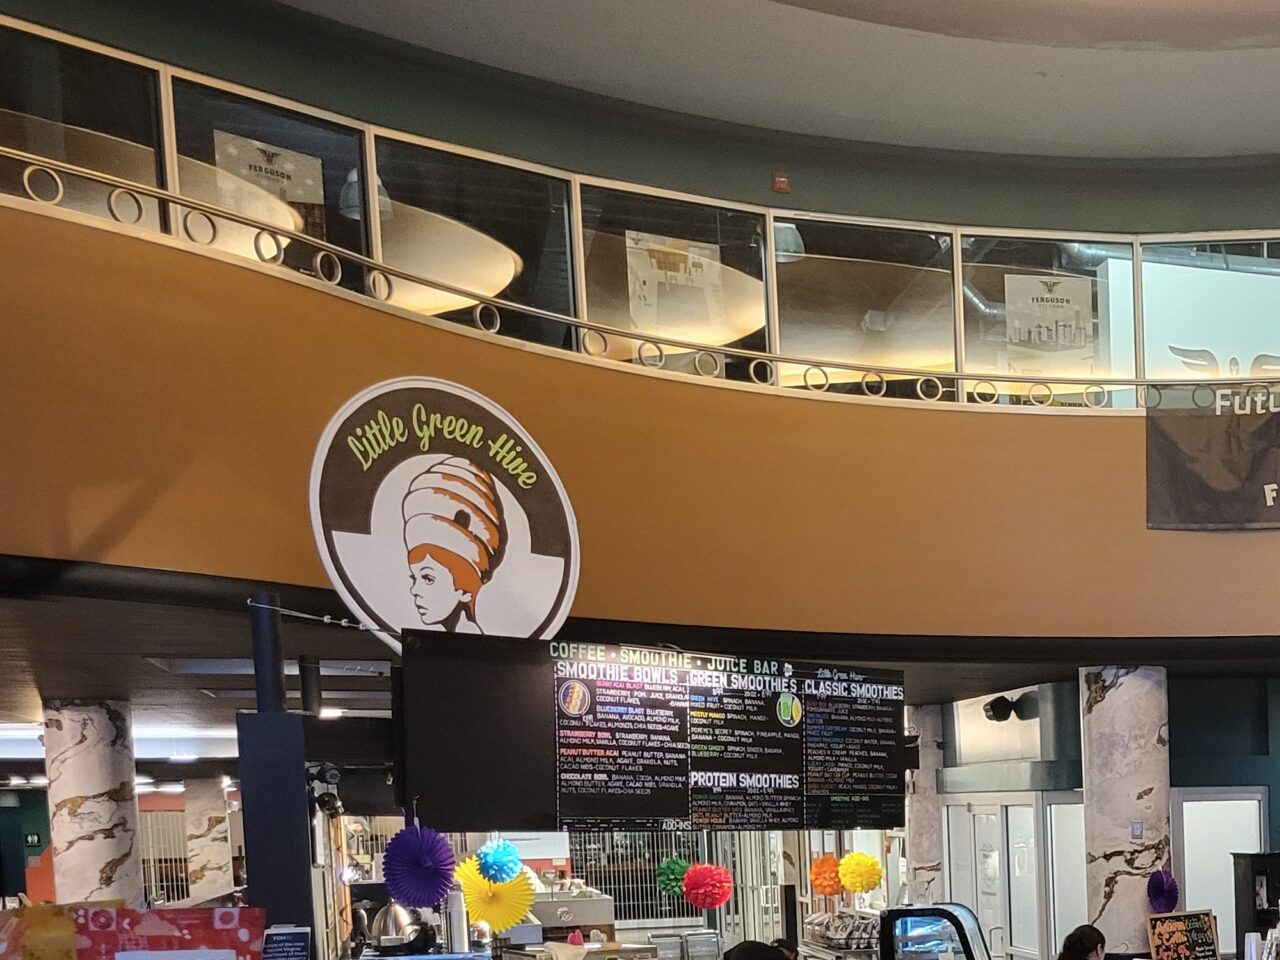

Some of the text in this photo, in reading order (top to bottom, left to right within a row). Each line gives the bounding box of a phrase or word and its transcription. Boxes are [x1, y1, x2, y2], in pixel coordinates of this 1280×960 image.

[1032, 297, 1070, 305] FERGUSON
[348, 403, 537, 489] Little Green Hive
[549, 642, 779, 675] COFFEE SMOOTHIE JUICE BAR
[557, 661, 679, 684] SMOOTHIE BOWLS
[690, 670, 798, 692] GREEN SMOOTHIES
[804, 680, 904, 700] CLASSIC SMOOTHIES
[690, 771, 799, 789] PROTEIN SMOOTHIES
